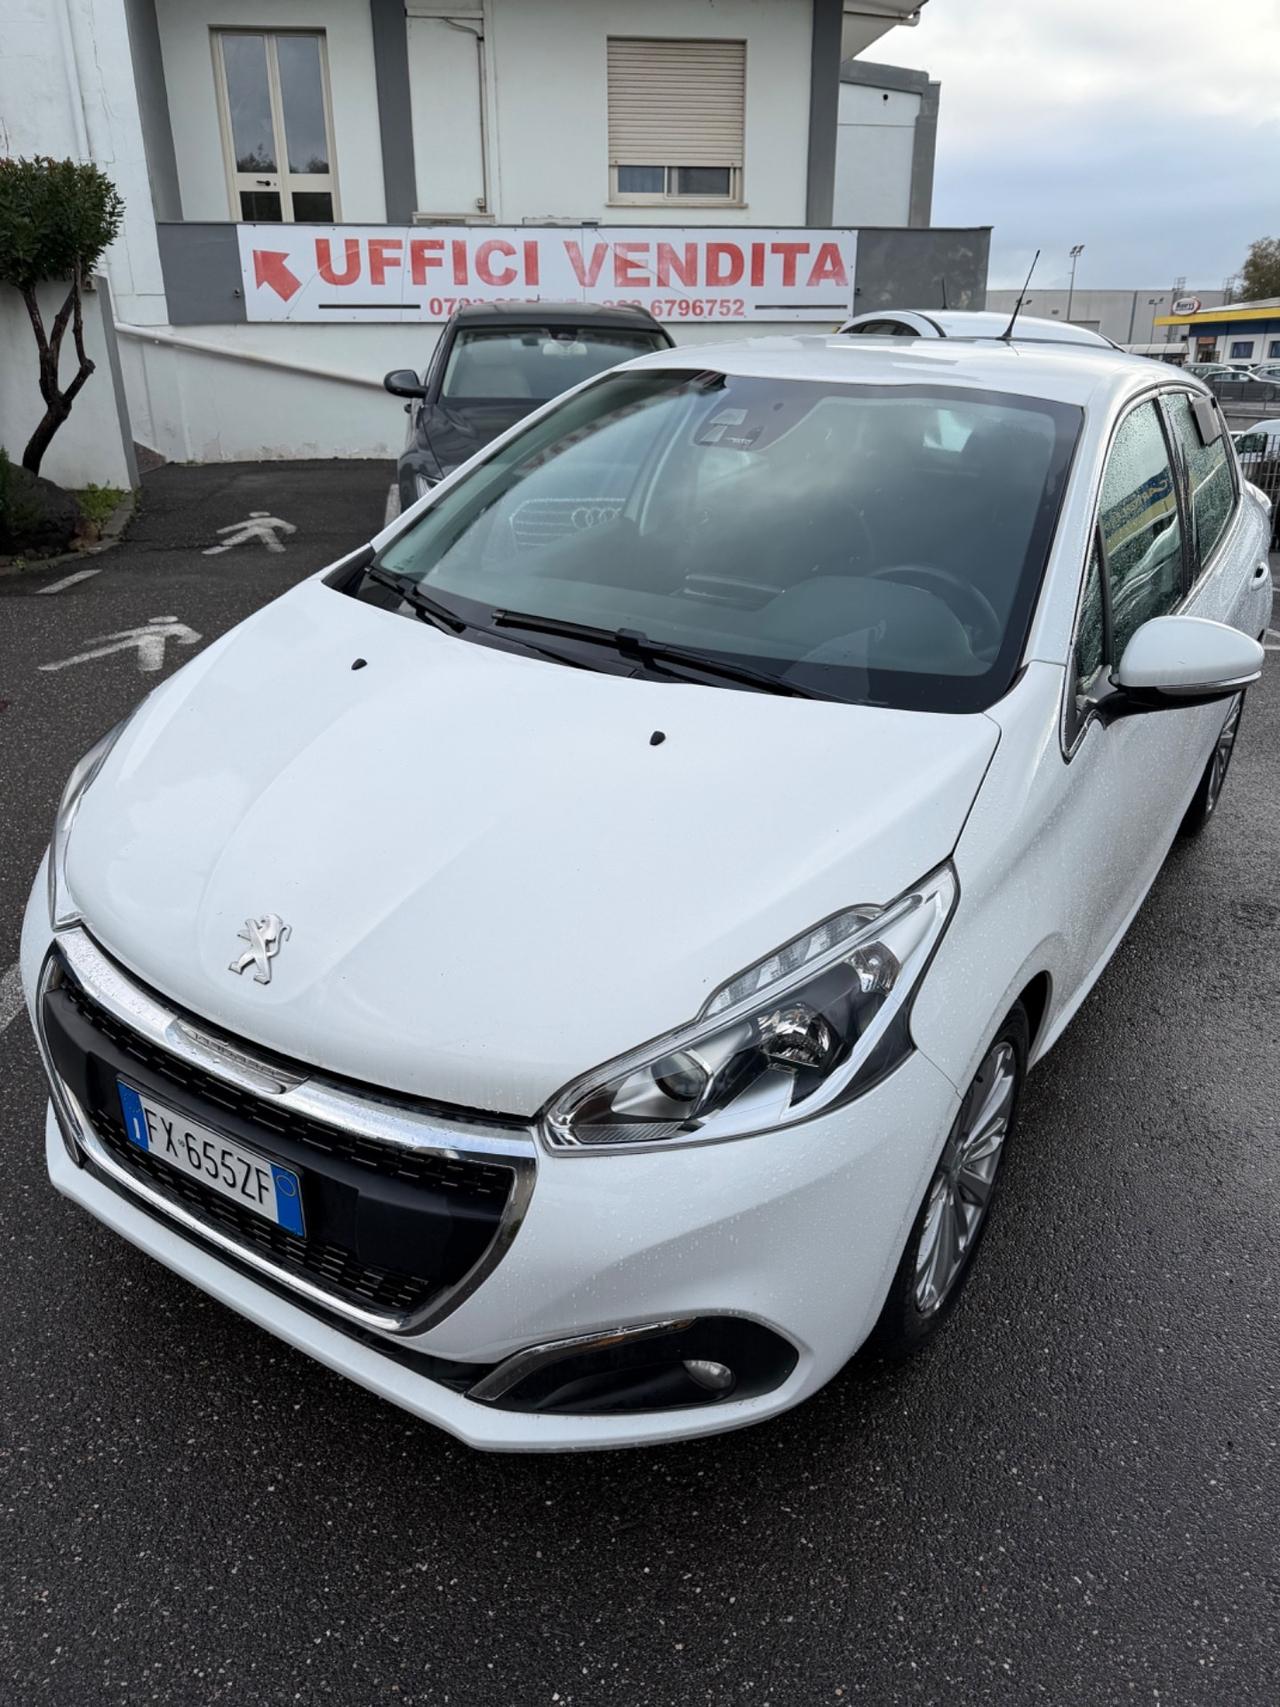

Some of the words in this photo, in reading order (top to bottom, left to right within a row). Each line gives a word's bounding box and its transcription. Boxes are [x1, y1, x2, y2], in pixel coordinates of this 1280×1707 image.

[315, 238, 540, 287] UFFICI
[563, 240, 849, 288] VENDITA
[650, 298, 745, 318] 6796752
